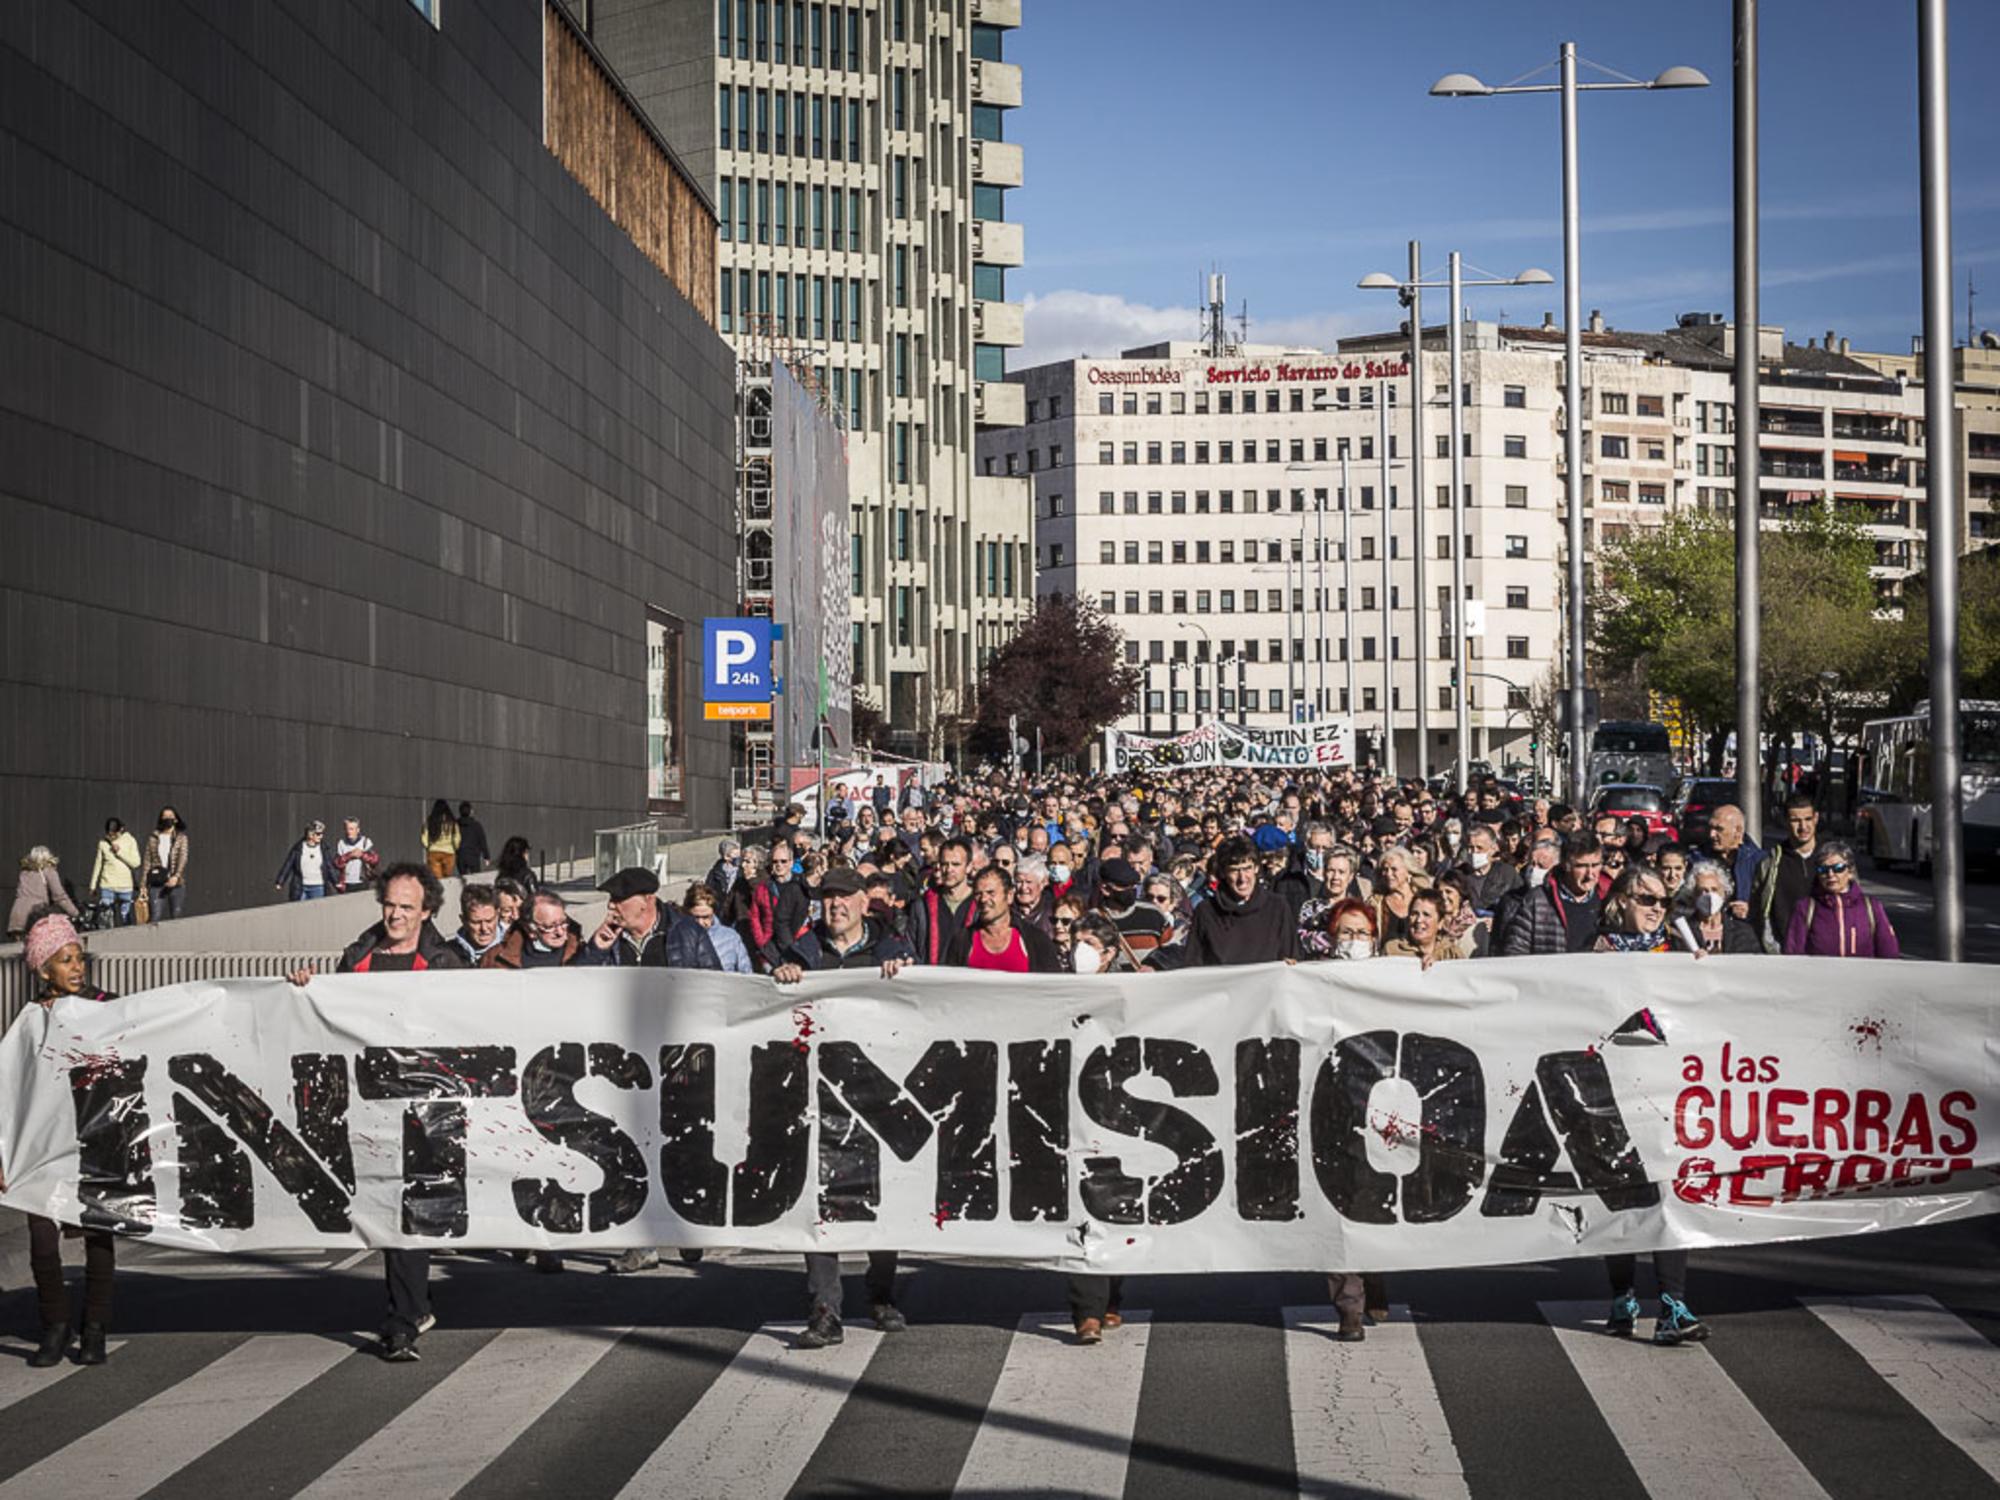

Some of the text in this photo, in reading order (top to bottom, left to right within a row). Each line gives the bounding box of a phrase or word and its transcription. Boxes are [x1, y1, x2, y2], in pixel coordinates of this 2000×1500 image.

[1088, 367, 1181, 385] Osasunbidea
[1207, 360, 1409, 384] Servicio Navarro de Salud
[716, 630, 756, 685] P
[731, 671, 760, 686] 24h
[1249, 724, 1340, 746] PUTIN EZ
[1247, 745, 1309, 764] NATO
[1682, 1041, 1780, 1083] a las
[70, 1028, 1660, 1236] INTSUMISIOA
[1674, 1085, 1978, 1156] GUERRAS
